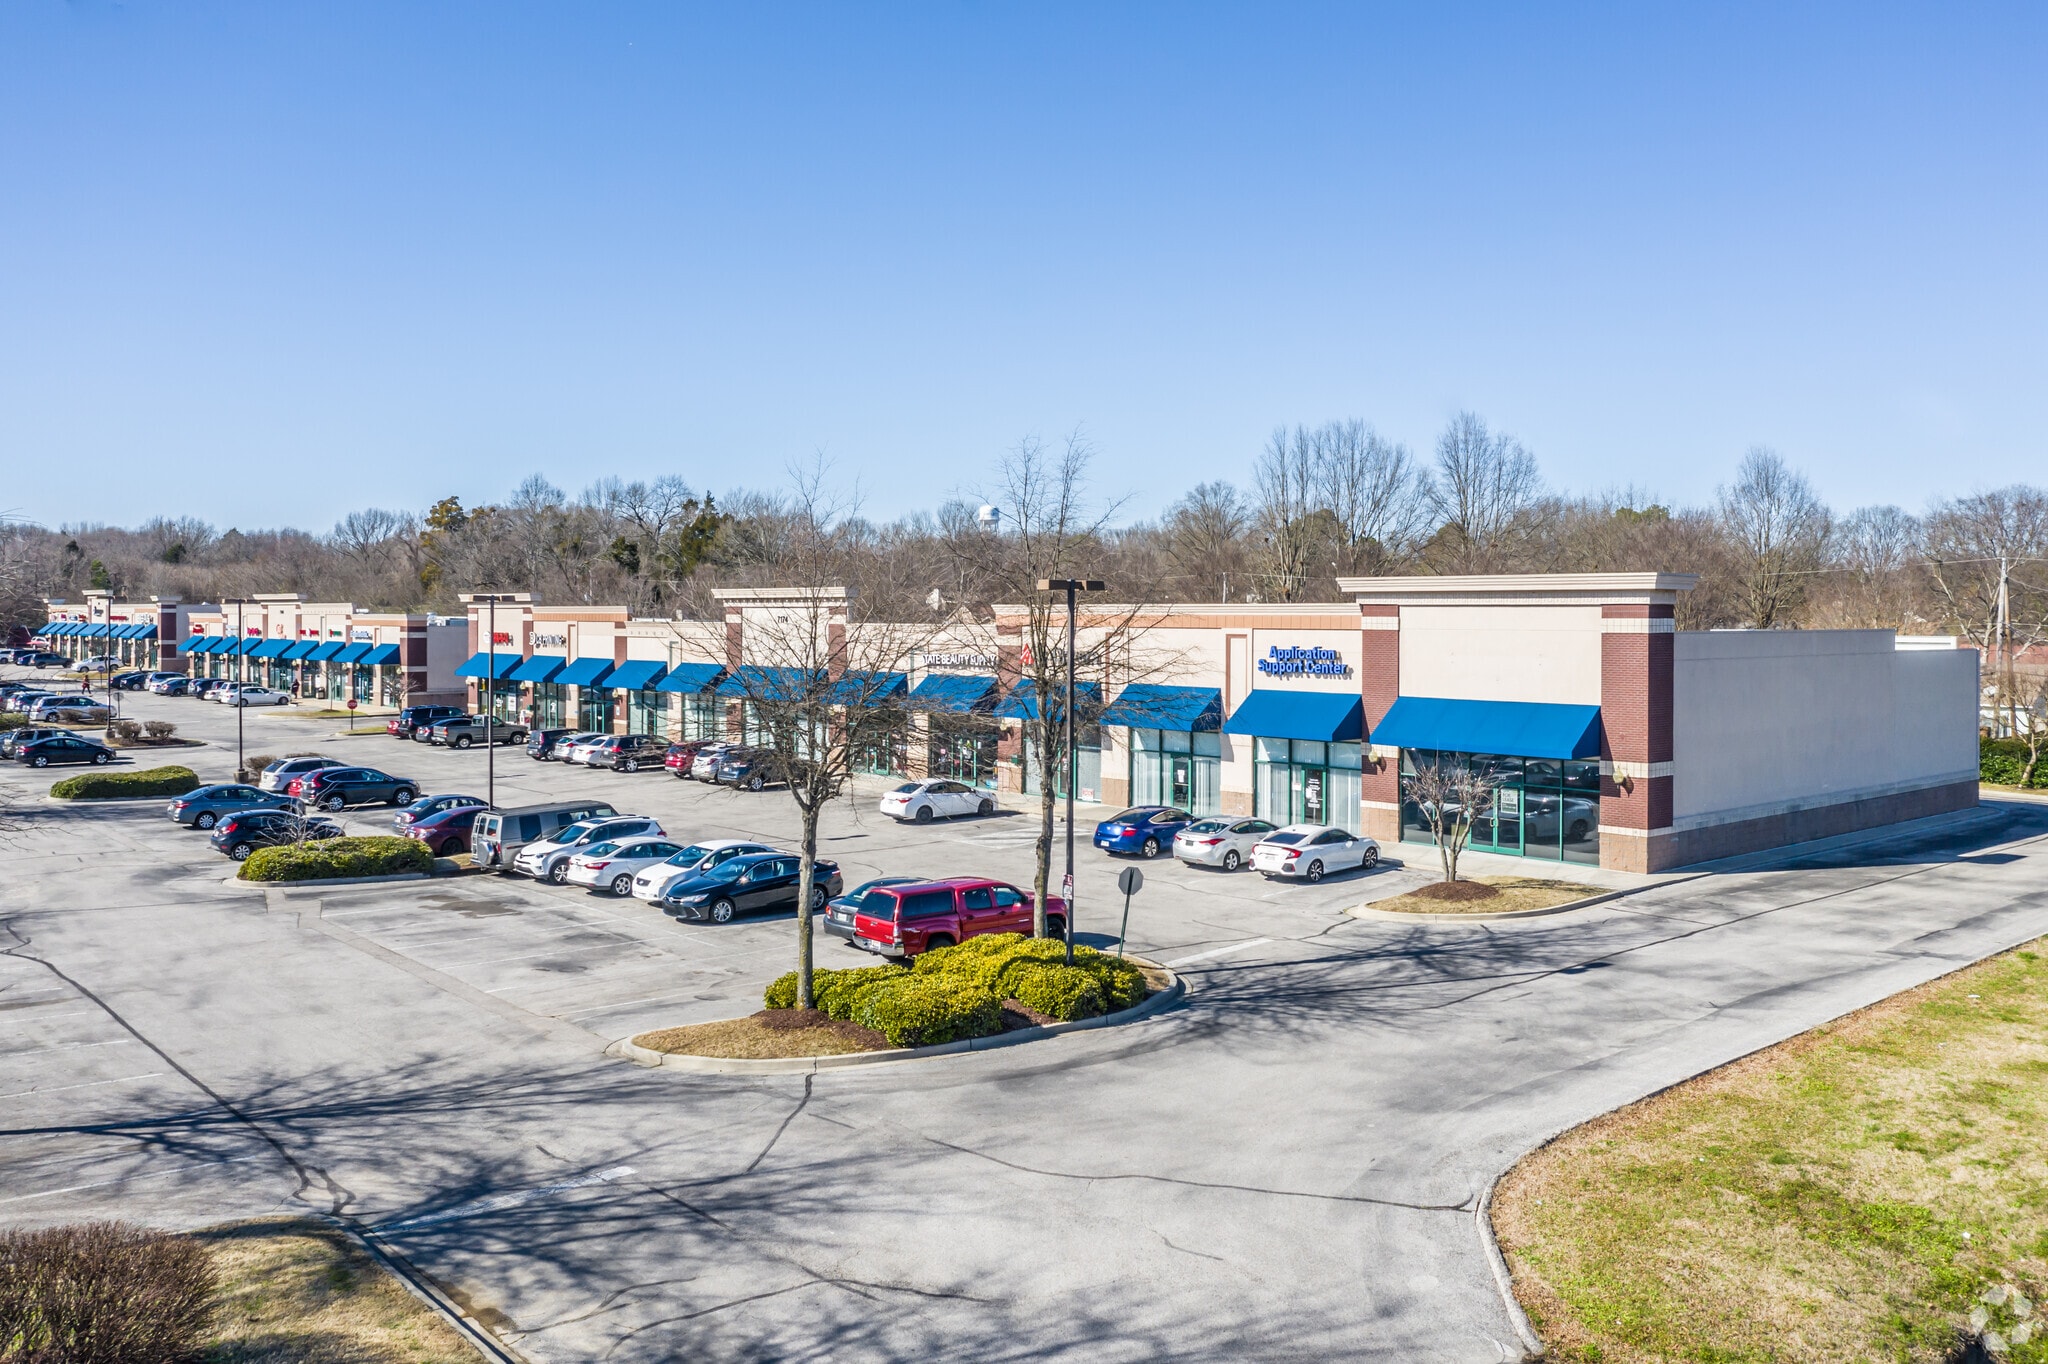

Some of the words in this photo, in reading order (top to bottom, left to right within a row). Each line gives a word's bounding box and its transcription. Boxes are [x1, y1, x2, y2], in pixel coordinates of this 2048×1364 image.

[940, 653, 970, 666] BEAUTY
[970, 654, 997, 666] SUPPY
[1269, 646, 1337, 661] Application
[1258, 659, 1305, 676] Support
[1306, 661, 1348, 674] Center
